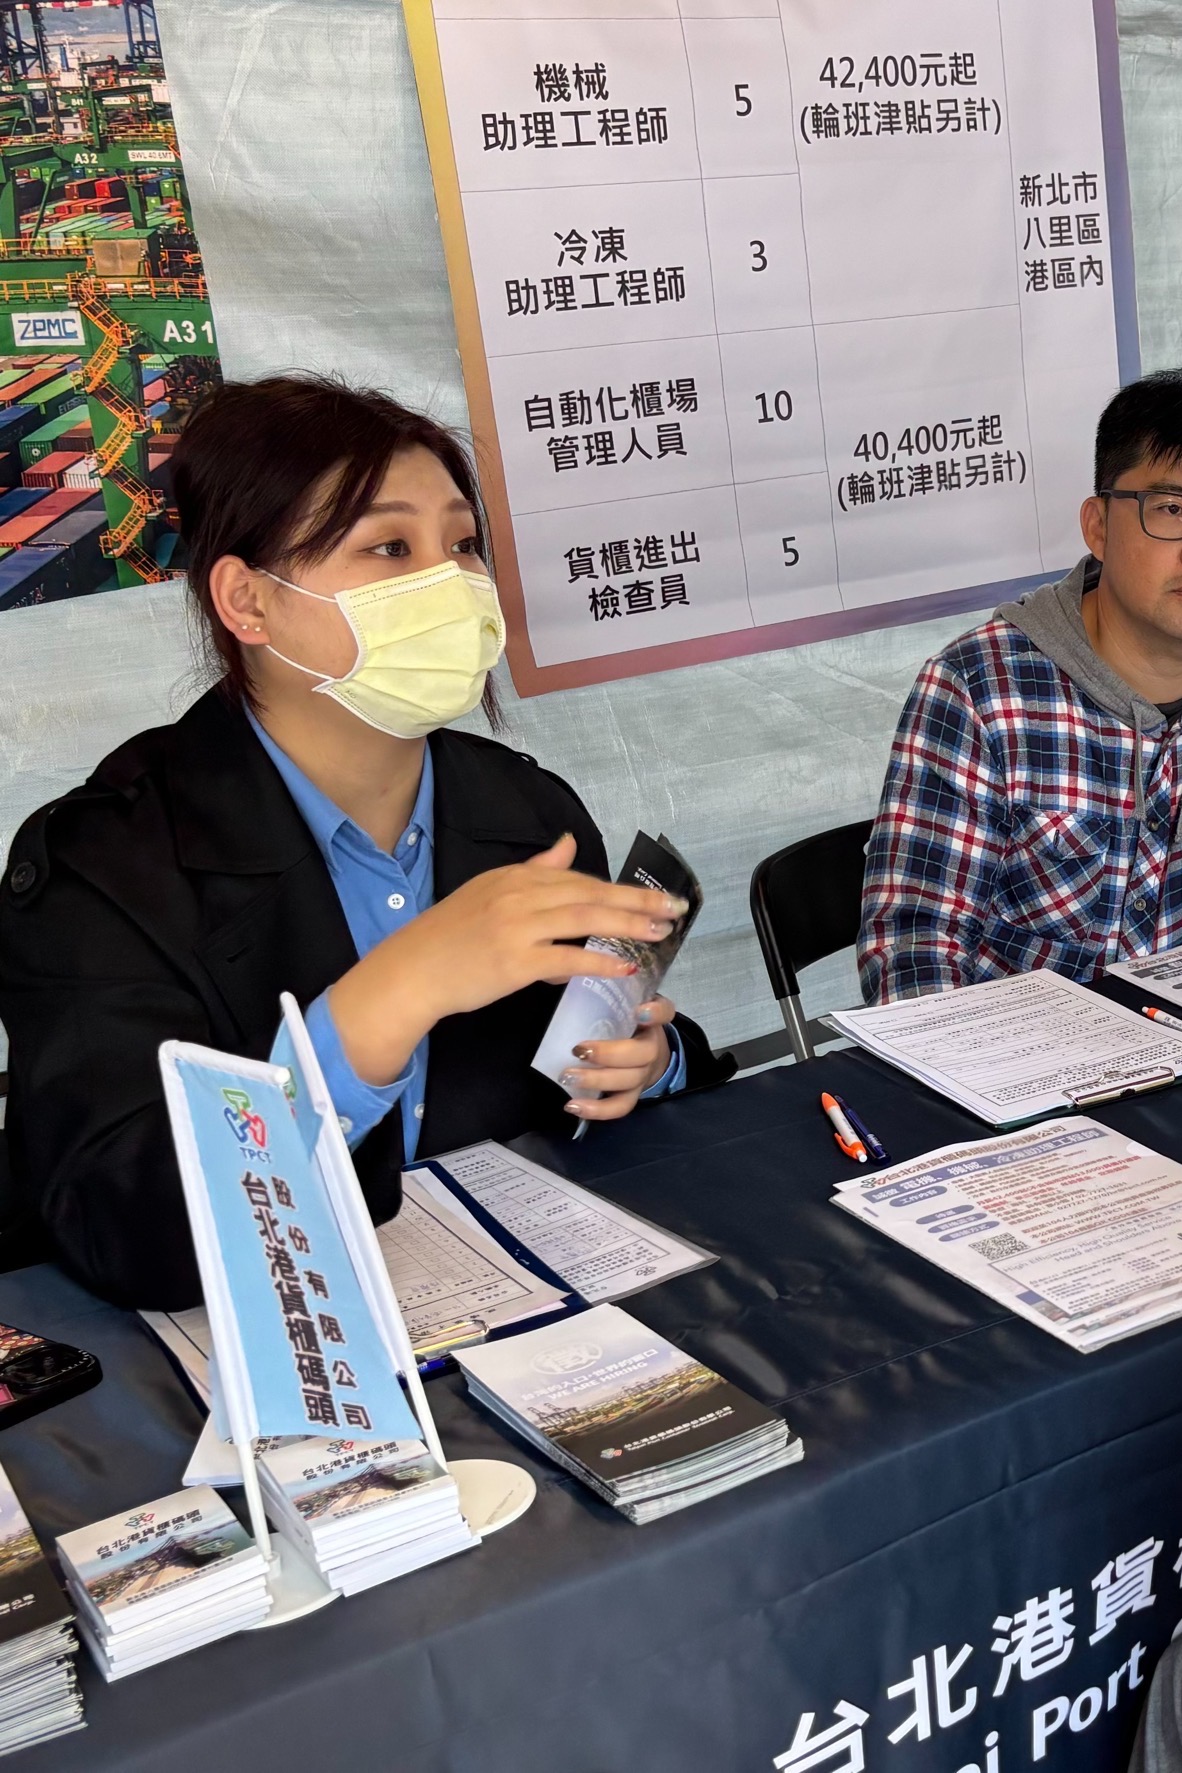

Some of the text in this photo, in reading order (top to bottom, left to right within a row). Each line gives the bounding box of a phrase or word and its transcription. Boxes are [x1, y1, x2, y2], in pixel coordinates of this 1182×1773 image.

[533, 62, 609, 103] 機械
[819, 52, 978, 93] 42,400元起
[733, 84, 753, 116] 5
[800, 97, 1002, 144] (輪班津貼另計)
[482, 105, 669, 152] 助理工程師
[74, 153, 98, 164] A32
[1018, 171, 1099, 207] 新北市
[554, 227, 628, 267] 冷凍
[1022, 213, 1103, 250] 八里區
[750, 240, 768, 272] 3
[1023, 256, 1104, 293] 港區內
[504, 266, 687, 317] 助理工程師
[18, 318, 79, 341] ZPMC
[163, 320, 214, 344] A31
[524, 378, 699, 433] 自動化櫃場
[755, 391, 793, 424] 10
[547, 423, 688, 473] 管理人員
[853, 415, 1004, 464] 40,400元起
[837, 451, 1027, 512] (輪班津貼另計)
[564, 530, 701, 583] 貨櫃進出
[782, 536, 801, 567] 5
[589, 574, 691, 622] 檢查員
[238, 1146, 272, 1164] TPCT
[240, 1170, 341, 1427] 台北港貨櫃碼頭
[271, 1176, 373, 1431] 股份有限公司
[548, 1361, 649, 1400] WE ARE HIRING
[1032, 1641, 1147, 1762] Port
